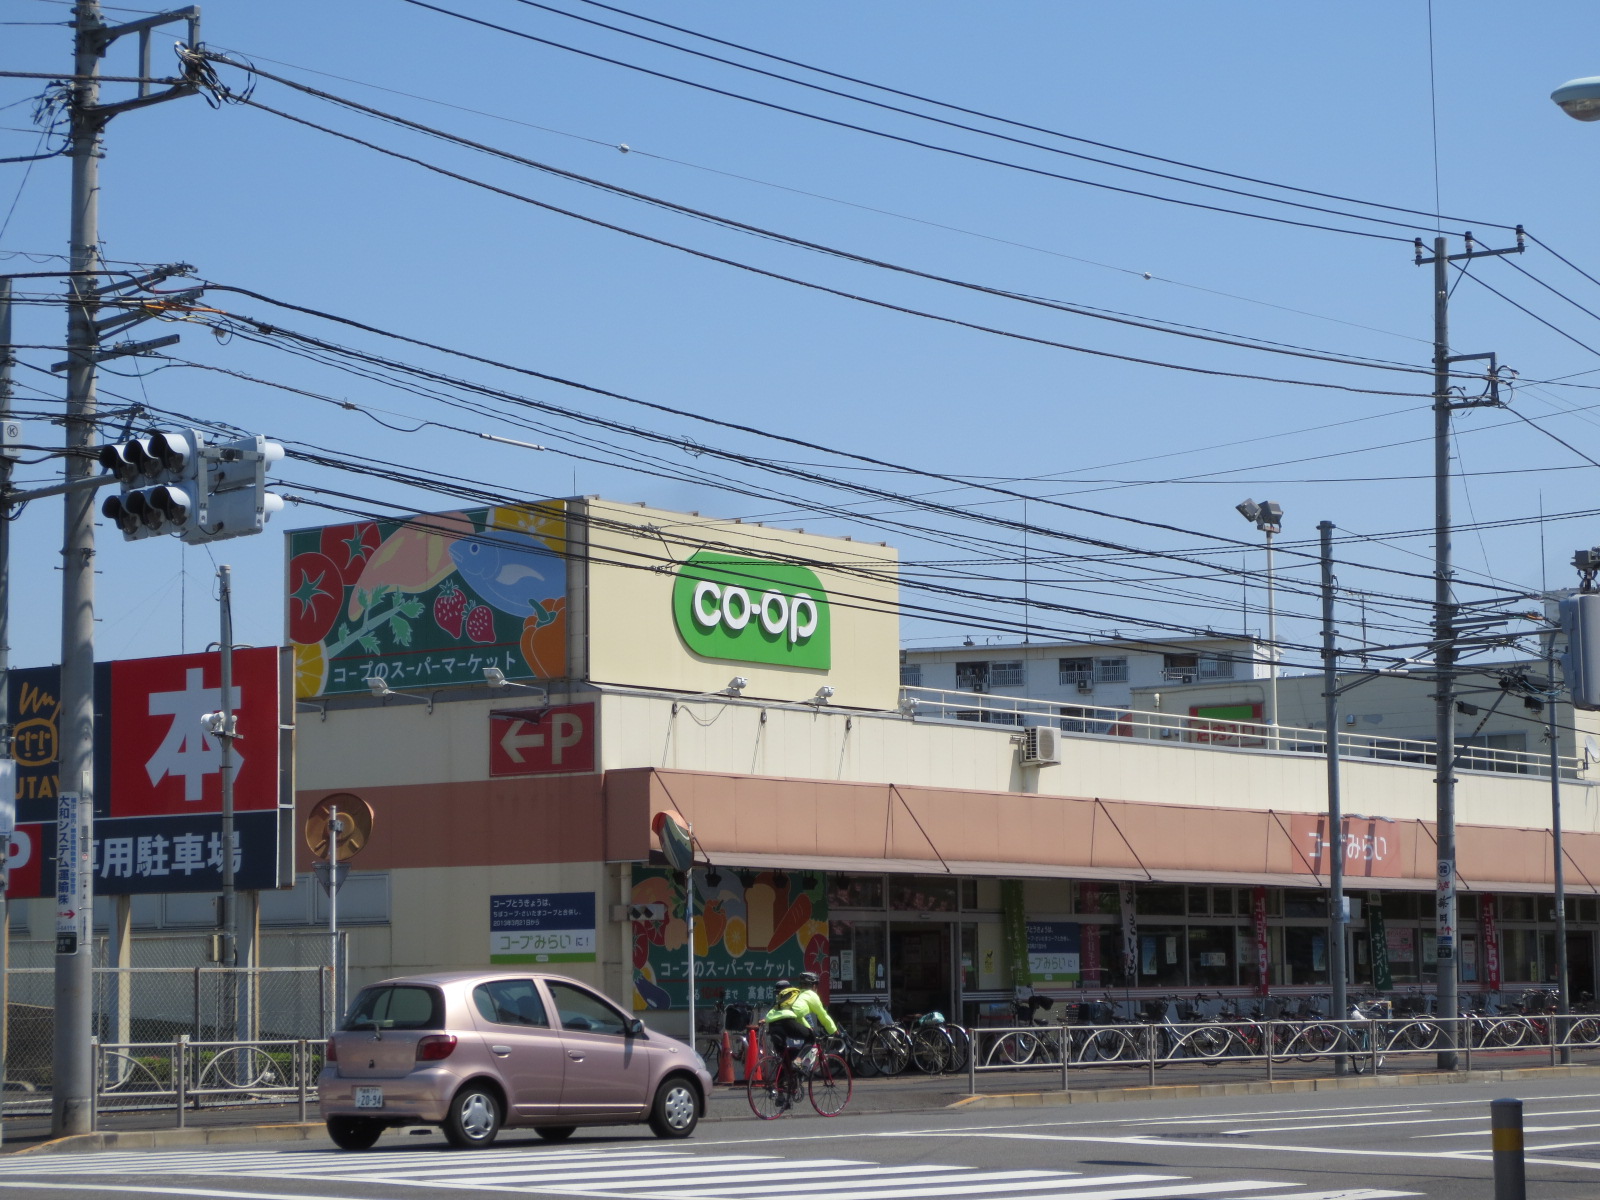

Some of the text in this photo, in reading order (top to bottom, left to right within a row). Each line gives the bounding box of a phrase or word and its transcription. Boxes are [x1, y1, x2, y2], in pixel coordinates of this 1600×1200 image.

[334, 651, 516, 683] コープのスーパーマーケット
[145, 668, 244, 801] 本
[552, 713, 583, 765] P
[15, 776, 60, 799] UTAY
[5, 830, 31, 891] P
[1308, 832, 1387, 861] コーみらい
[661, 959, 794, 977] コープのスーパーマーケット
[361, 1095, 381, 1106] 20-94
